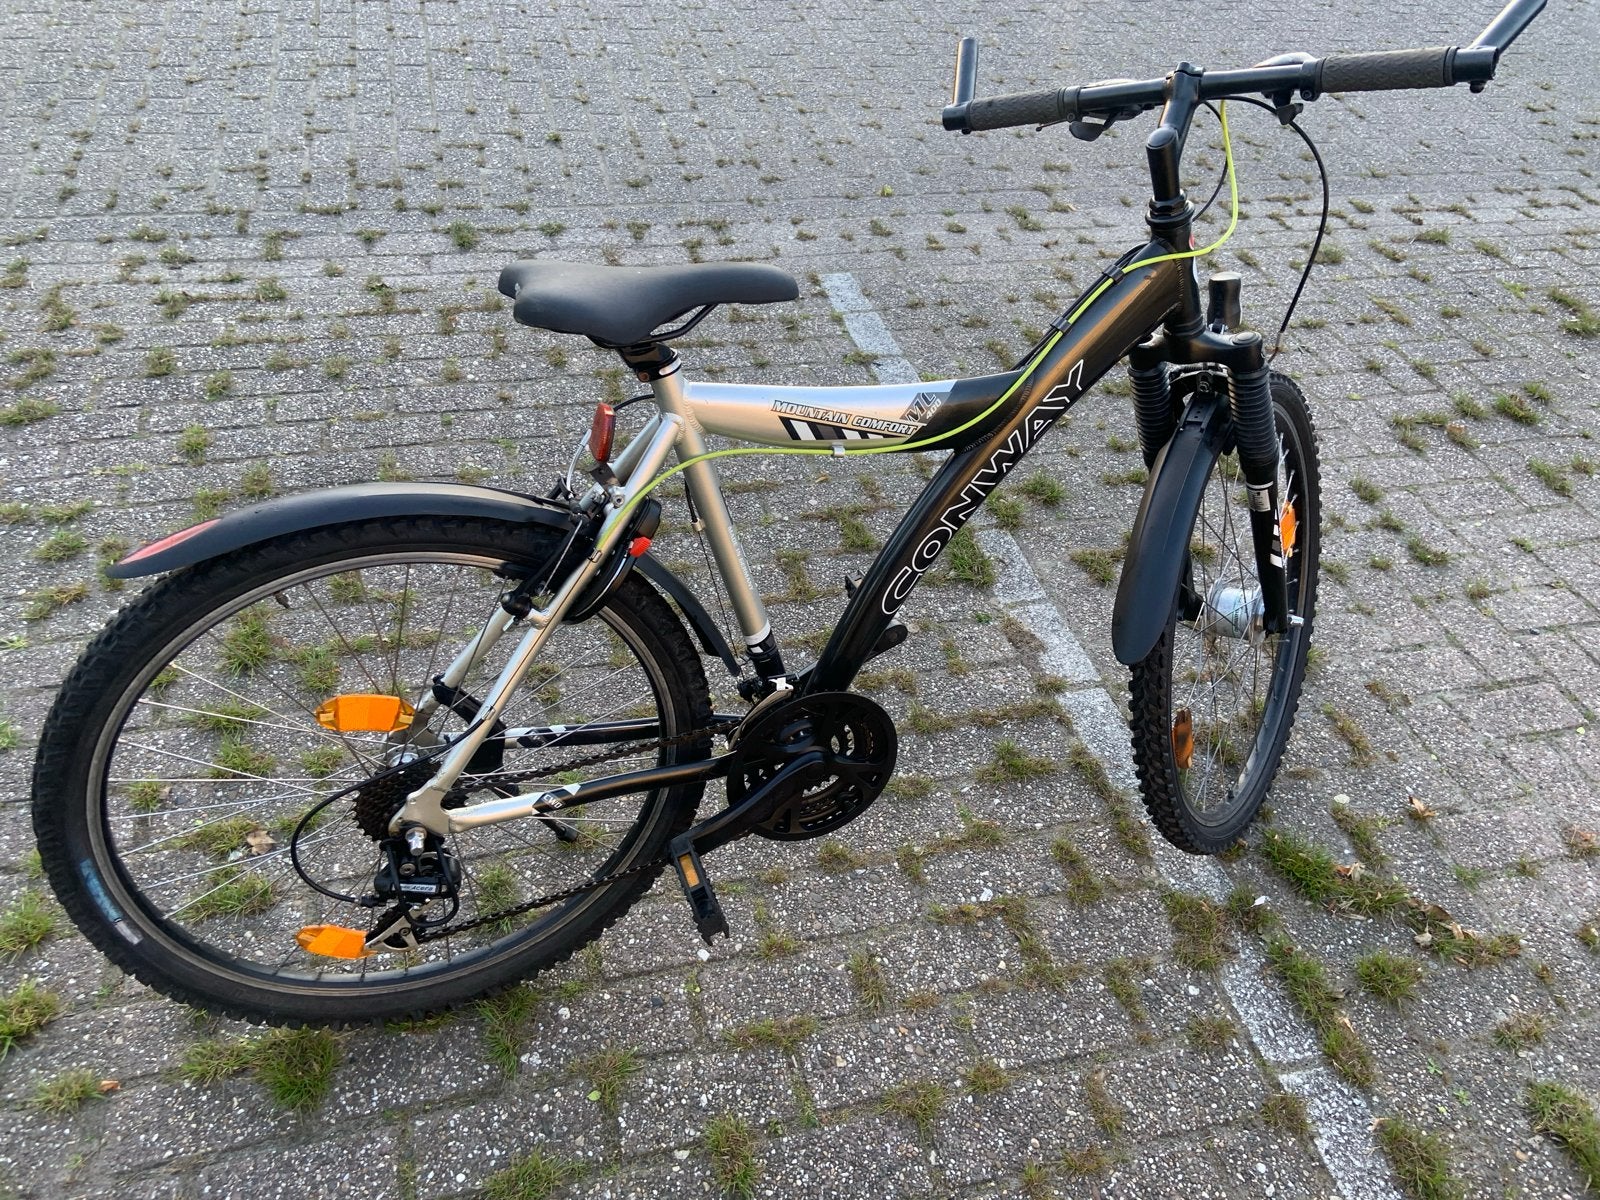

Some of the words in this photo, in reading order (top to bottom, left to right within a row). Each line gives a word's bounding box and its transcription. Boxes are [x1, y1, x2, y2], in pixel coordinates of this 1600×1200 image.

[770, 399, 851, 424] MOUNTAIN
[851, 415, 918, 436] COMFORT
[926, 398, 942, 419] 400
[881, 358, 1084, 615] CONWAY
